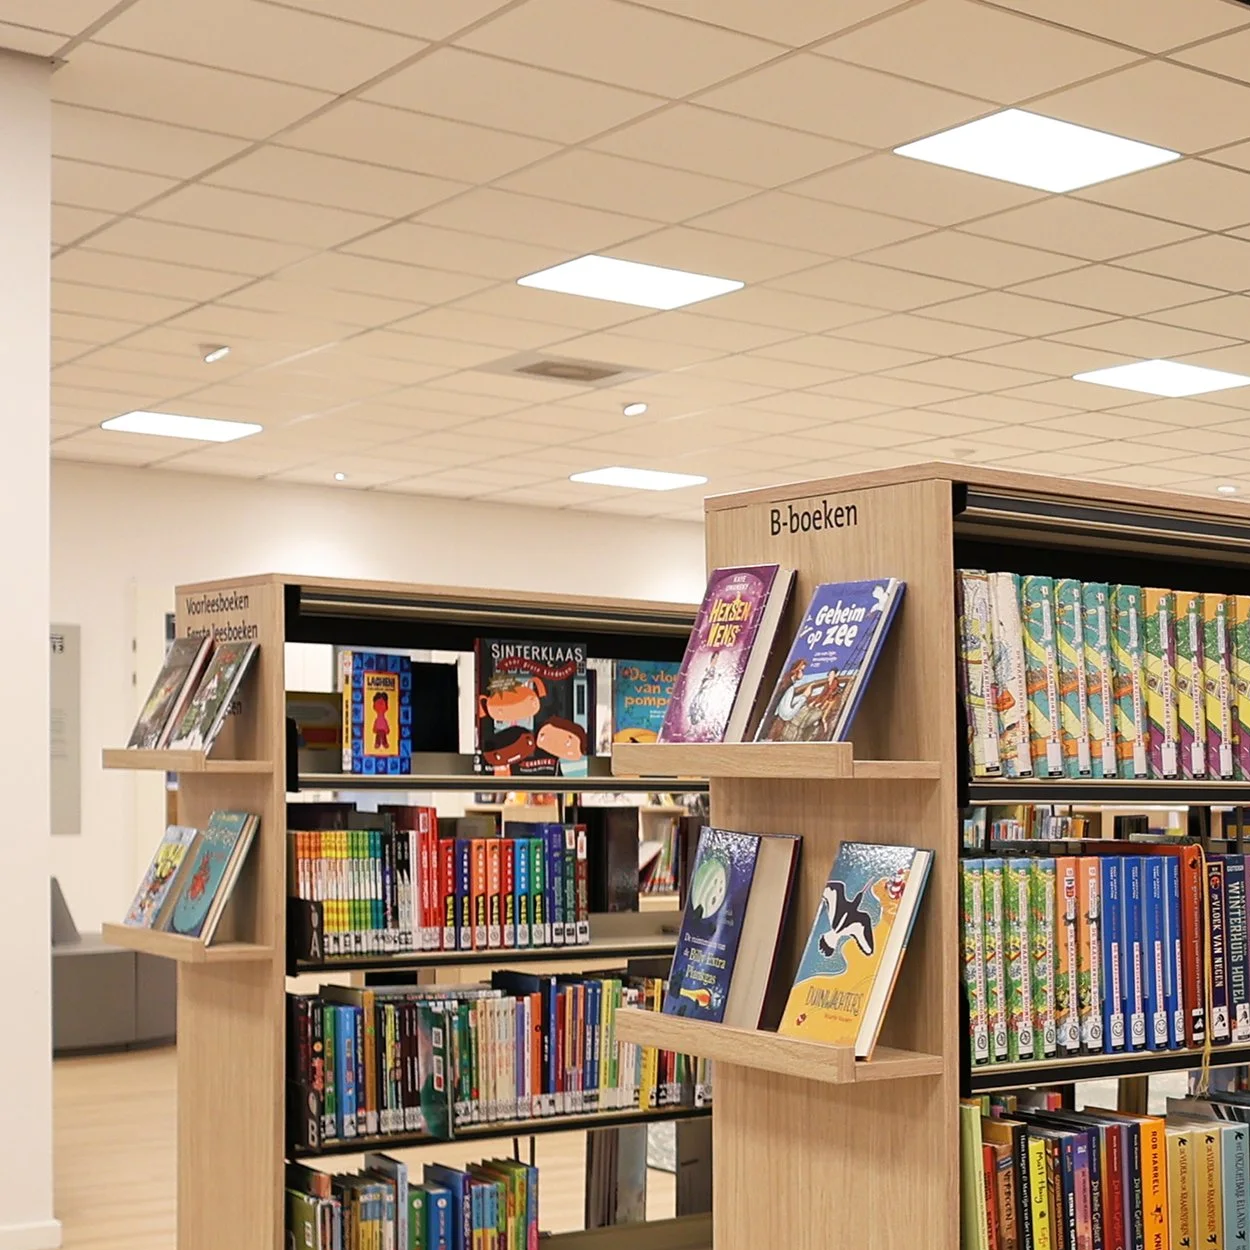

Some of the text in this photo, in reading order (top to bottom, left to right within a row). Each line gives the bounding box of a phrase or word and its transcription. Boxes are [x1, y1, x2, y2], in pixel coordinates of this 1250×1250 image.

[770, 500, 858, 536] B-boeken
[186, 591, 249, 615] Voorleesboeken
[708, 599, 751, 623] HEKSEN
[816, 600, 865, 626] Geheim
[212, 620, 258, 642] leesboeken
[707, 623, 737, 648] WENS
[807, 625, 858, 649] op zee
[491, 643, 583, 662] SINTERKLAAS
[630, 668, 647, 681] De
[635, 684, 661, 693] van
[625, 696, 671, 708] pomp
[1212, 900, 1223, 987] VLOEK VAN NEGEN
[1228, 882, 1245, 1003] WINTERHUIS HOTEL
[806, 986, 864, 1016] DUINWACHTERS
[1034, 1152, 1045, 1203] Matt Haig
[1151, 1153, 1159, 1196] HARRELL
[1236, 1200, 1245, 1229] EILAND
